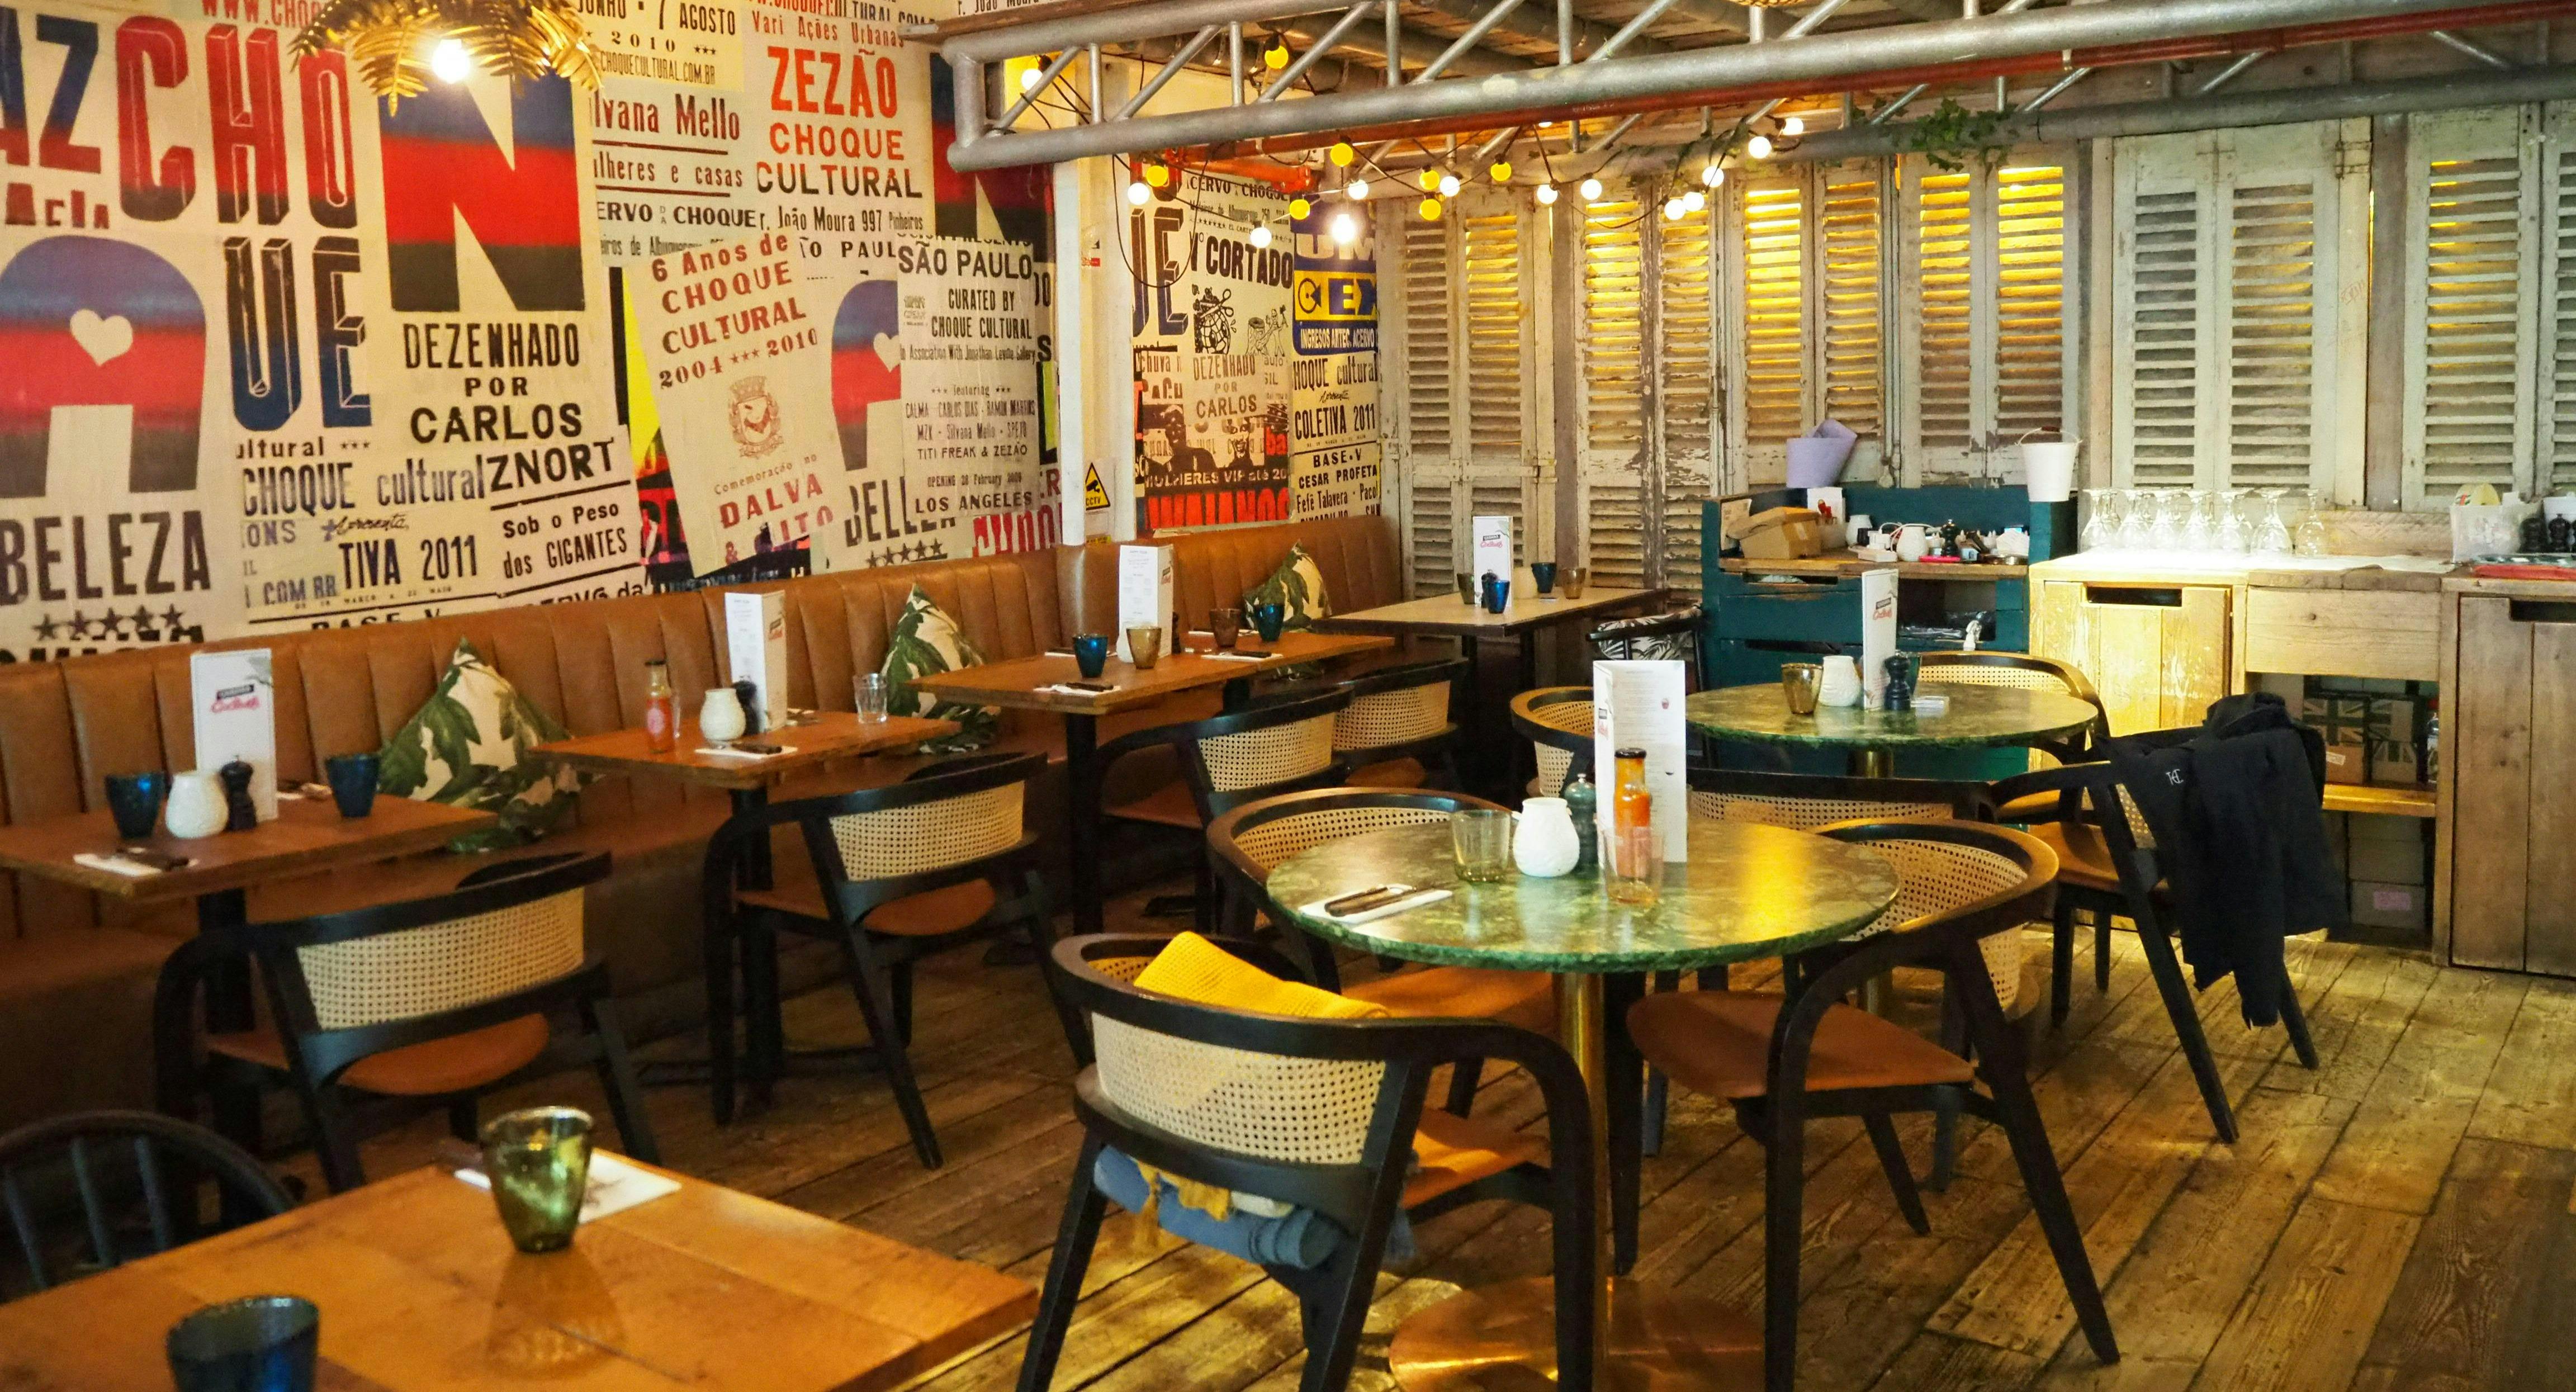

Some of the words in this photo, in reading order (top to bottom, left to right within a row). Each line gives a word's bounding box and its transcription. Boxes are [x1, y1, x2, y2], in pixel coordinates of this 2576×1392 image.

[679, 2, 736, 35] AGOSTO
[752, 11, 783, 35] Vari
[798, 16, 838, 41] Ações
[611, 30, 676, 53] 2010
[767, 45, 898, 119] ZEZÃO
[675, 93, 740, 140] Mello
[769, 122, 905, 161] CHOQUE
[671, 165, 679, 183] e
[695, 166, 743, 187] casas
[756, 161, 923, 198] CULTURAL
[673, 206, 756, 228] CHOQUE
[813, 206, 856, 232] Moura
[861, 210, 882, 231] 997
[652, 258, 668, 282] 6
[683, 244, 748, 276] Anos
[760, 233, 789, 257] de
[898, 240, 948, 276] SÃO
[956, 249, 1033, 280] PAULO
[1206, 235, 1294, 289] CORTADO
[662, 261, 793, 314] CHOQUE
[948, 288, 996, 311] CURATED
[1002, 290, 1015, 311] BY
[662, 297, 807, 354] CULTURAL
[931, 315, 972, 338] CHOQUE
[979, 317, 1032, 339] CULTURAL
[1300, 328, 1330, 349] INGRESOS
[403, 323, 580, 369] DEZENHADO
[659, 356, 723, 390] 2004
[766, 328, 818, 358] 2010
[948, 344, 963, 361] With
[1192, 354, 1256, 381] DEZENHADO
[1336, 353, 1378, 386] cultural
[464, 376, 529, 397] POR
[1214, 381, 1238, 394] POR
[905, 403, 929, 419] CALMA
[938, 401, 962, 418] CARLOS
[1196, 394, 1257, 419] CARLOS
[1294, 405, 1347, 441] COLETIVA
[1353, 403, 1375, 432] 2011
[410, 403, 582, 444] CARLOS
[917, 423, 933, 441] MZK
[486, 436, 615, 493] ZNORT
[917, 448, 937, 460] TITI
[941, 446, 977, 459] FREAK
[981, 447, 988, 457] &
[243, 462, 356, 517] CHOQUE
[377, 454, 486, 506] cultural
[974, 473, 1002, 486] February
[1299, 472, 1329, 490] CESAR
[1336, 465, 1377, 483] PROFETA
[719, 473, 823, 529] DALVA
[915, 496, 949, 514] LOS
[958, 491, 1033, 511] ANGELES
[1086, 496, 1101, 506] CCTV
[1317, 489, 1348, 509] Talavera
[503, 515, 539, 539] Sob
[552, 515, 562, 528] o
[572, 503, 619, 523] Peso
[338, 538, 402, 589] TIVA
[420, 534, 478, 582] 2011
[503, 552, 533, 579] dos
[546, 527, 627, 569] GIGANTES
